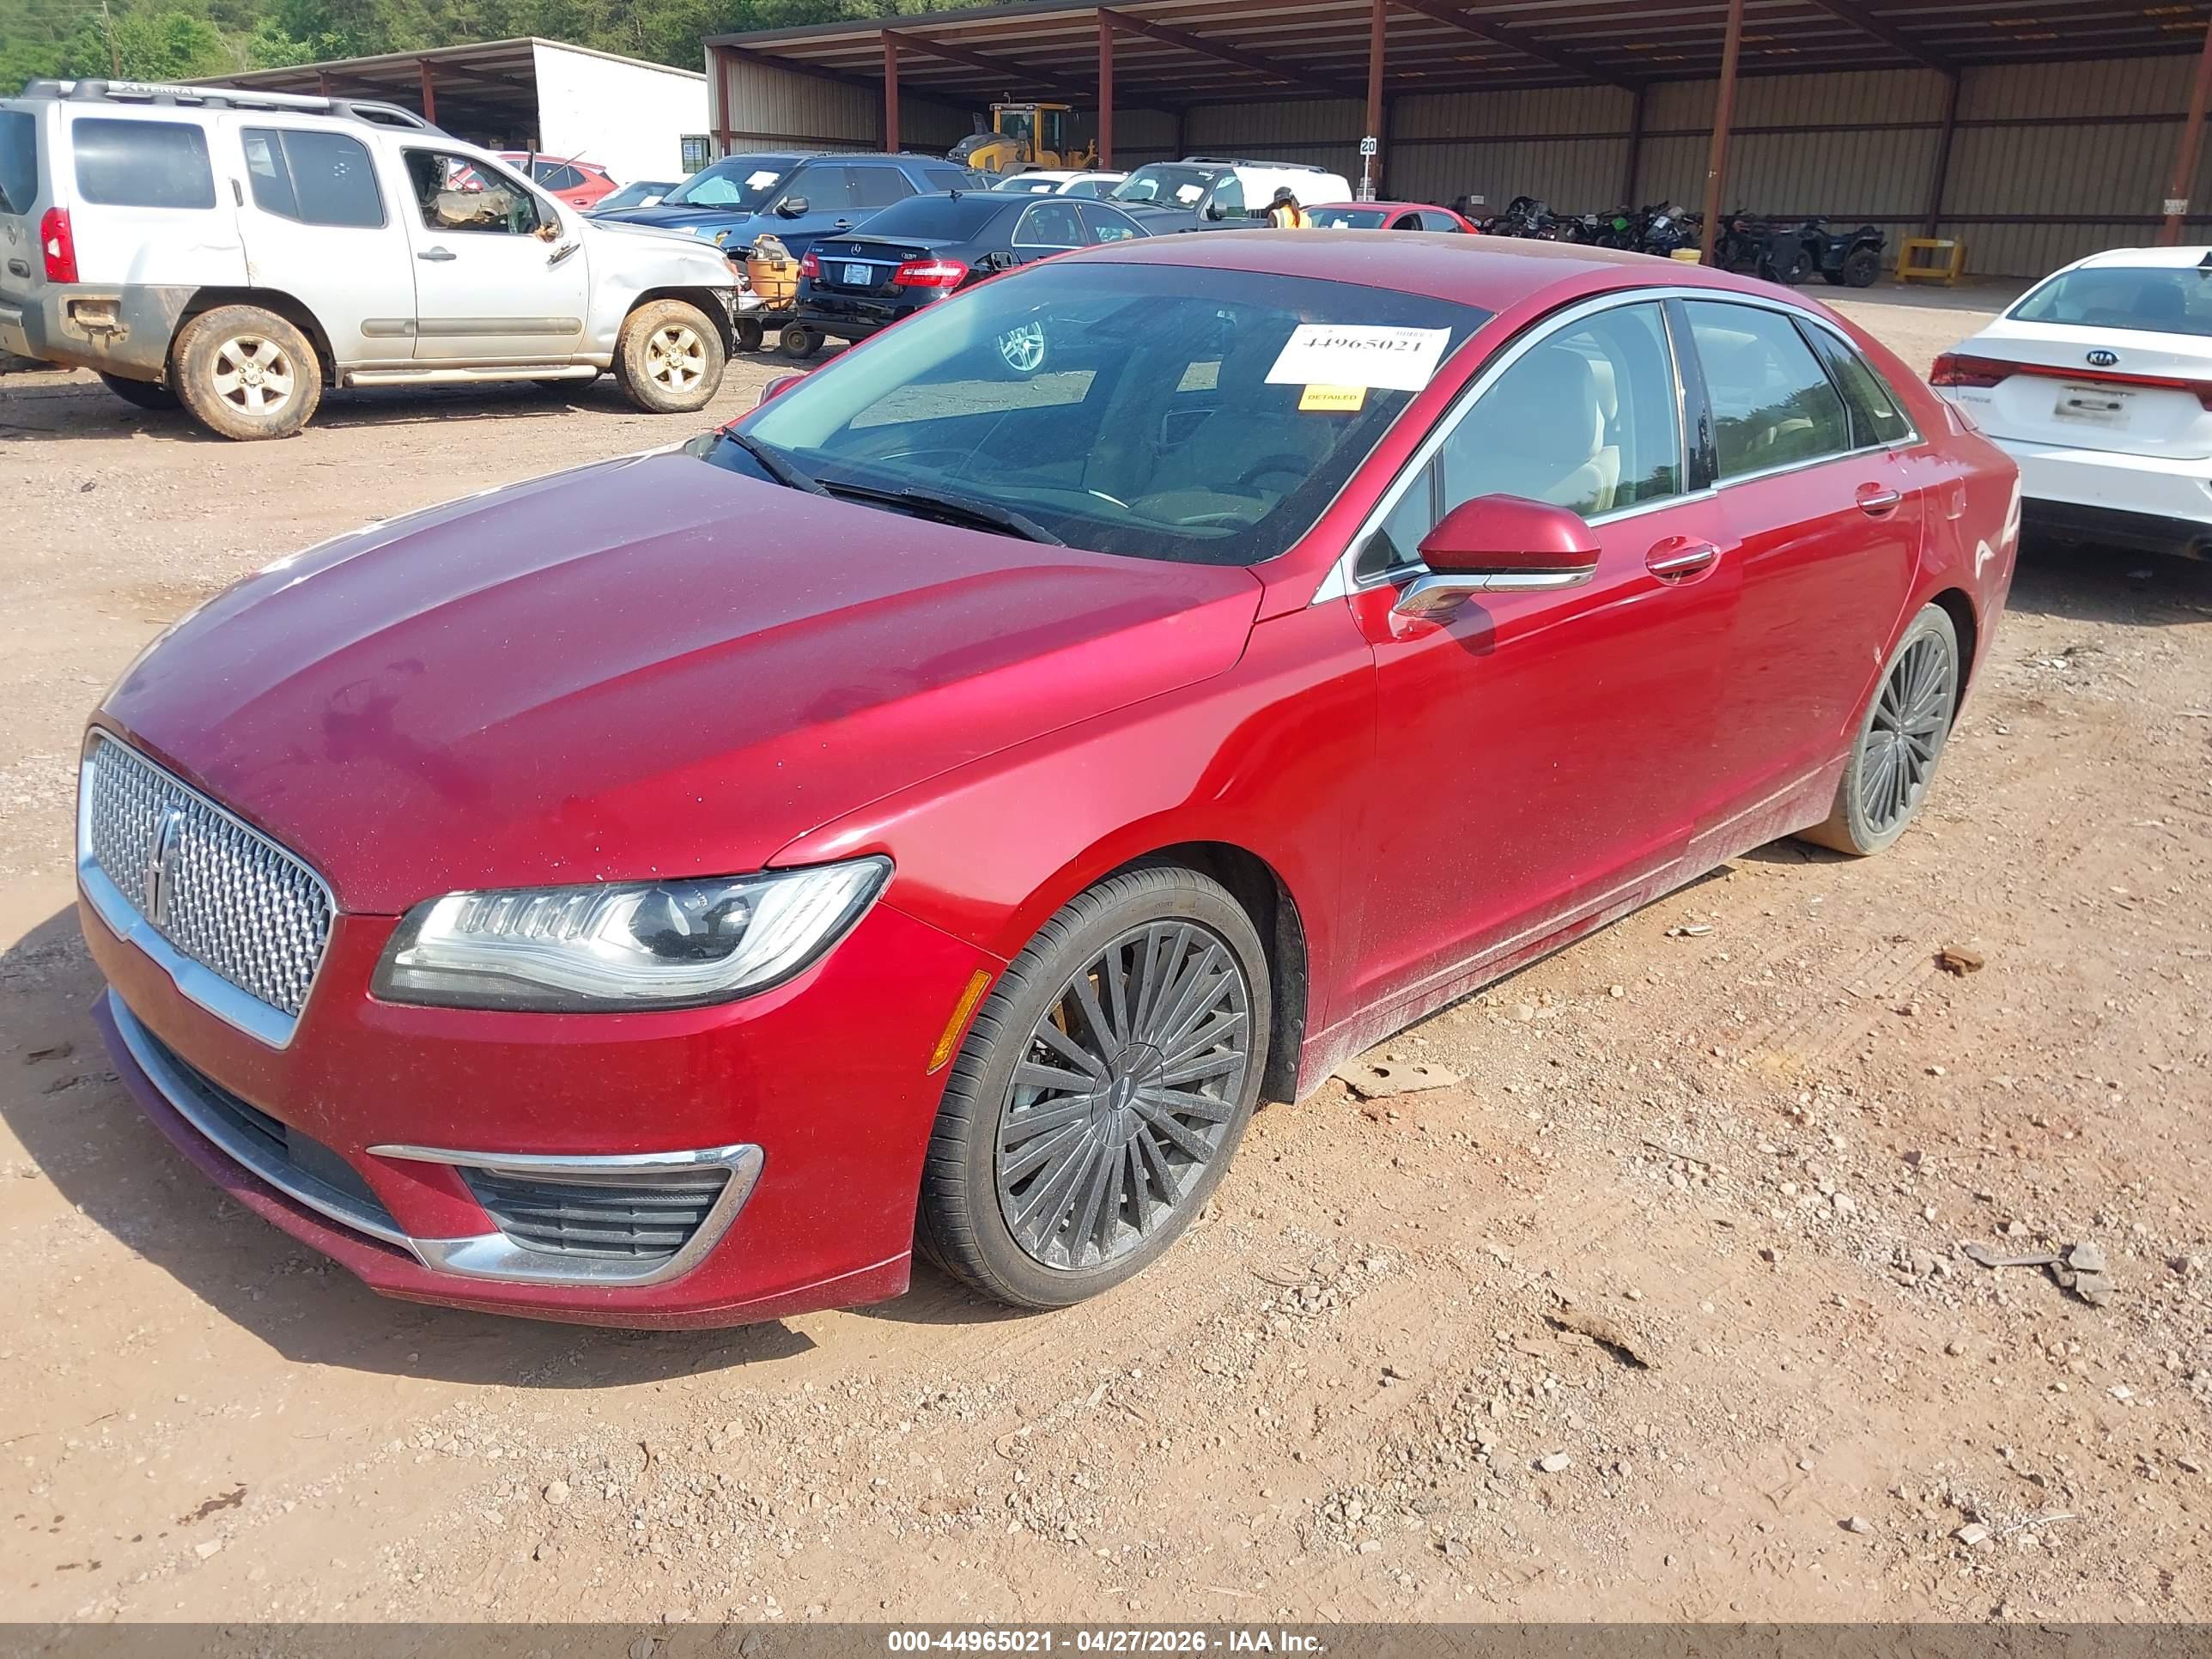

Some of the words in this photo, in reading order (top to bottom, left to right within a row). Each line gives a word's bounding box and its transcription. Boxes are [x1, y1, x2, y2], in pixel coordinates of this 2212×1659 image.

[120, 82, 193, 95] XTERRA
[1362, 141, 1376, 152] 20
[1303, 337, 1422, 352] 44965021
[2089, 352, 2113, 364] KIA
